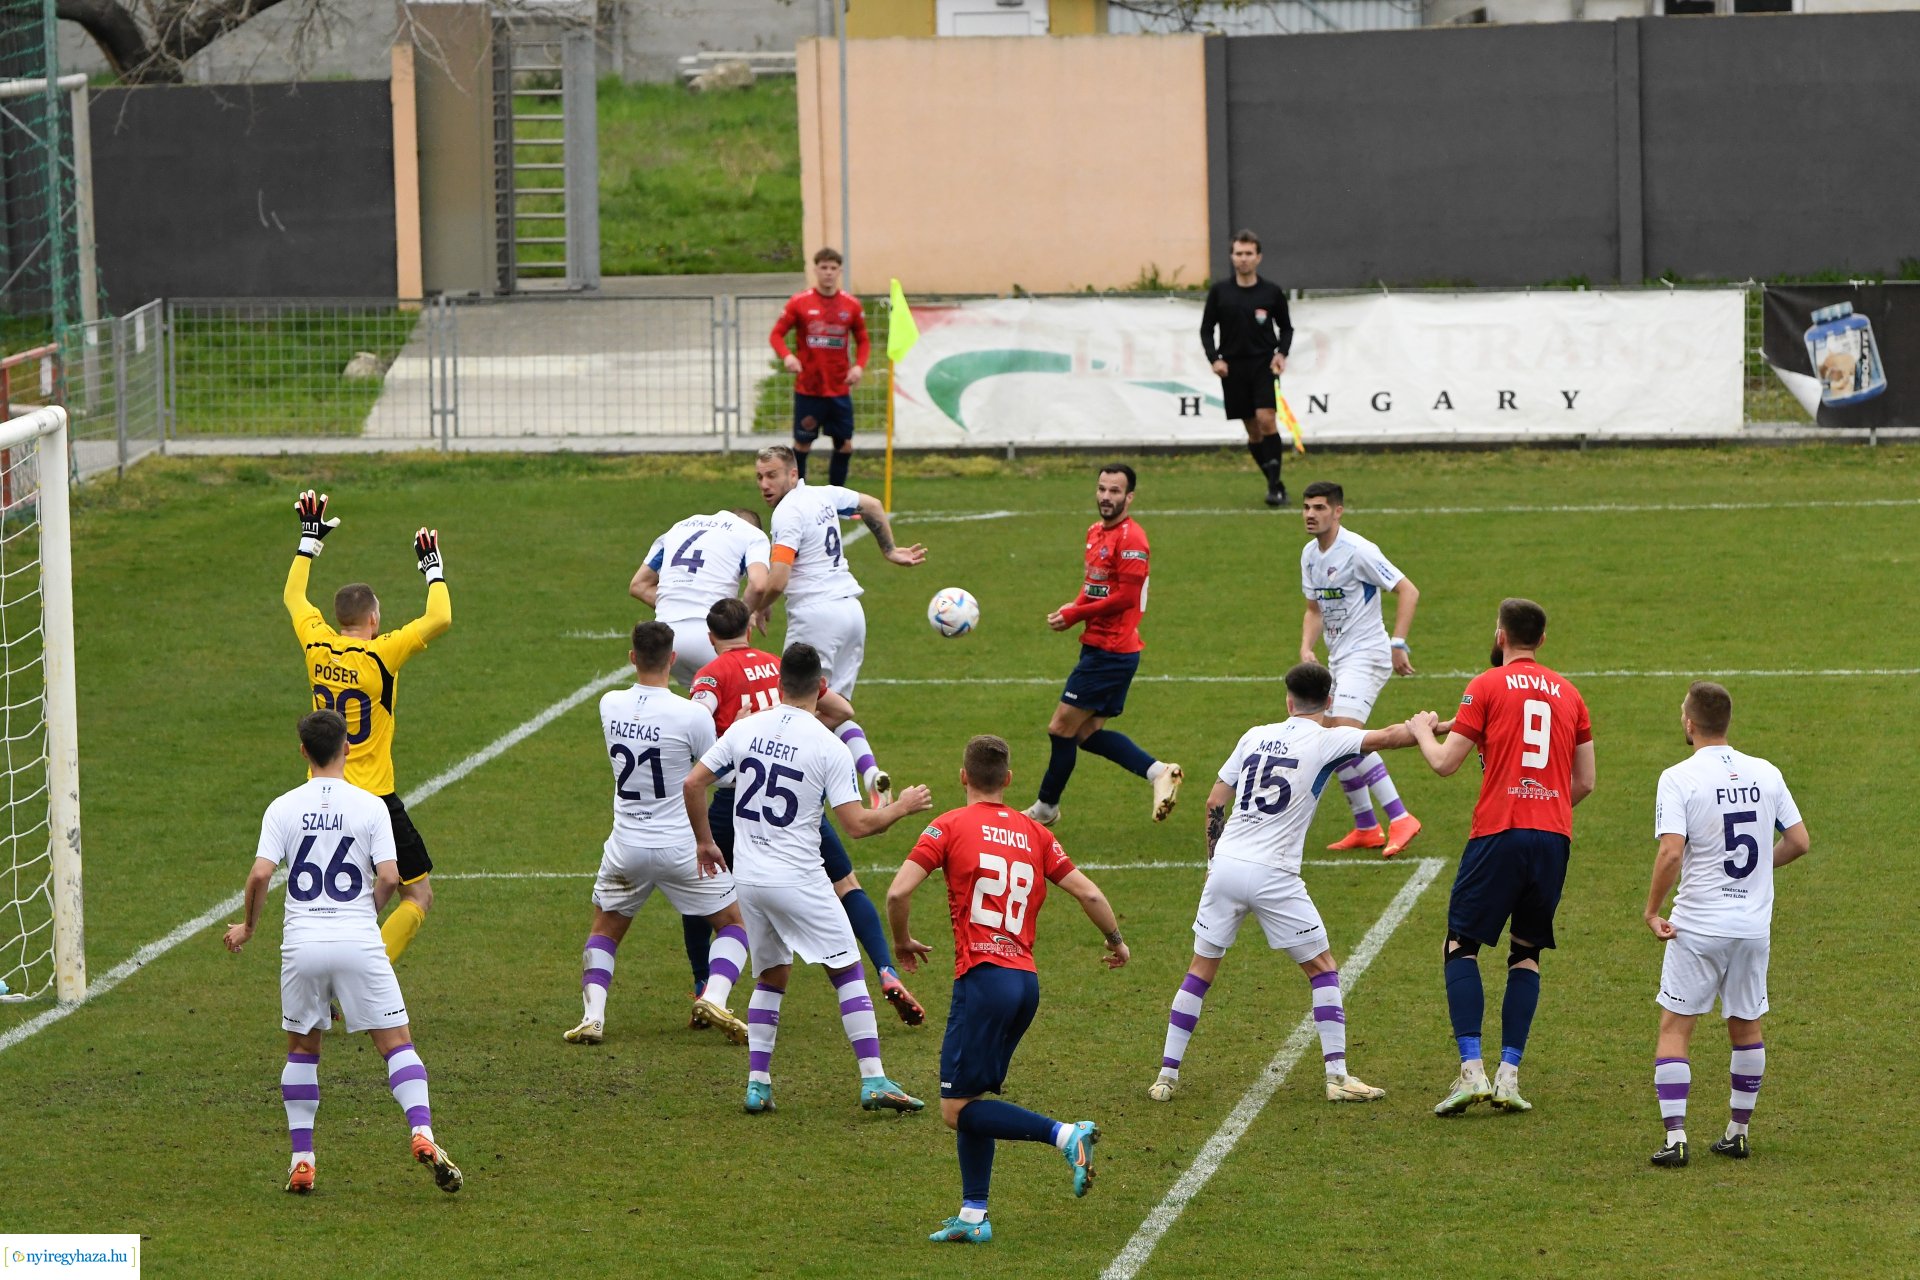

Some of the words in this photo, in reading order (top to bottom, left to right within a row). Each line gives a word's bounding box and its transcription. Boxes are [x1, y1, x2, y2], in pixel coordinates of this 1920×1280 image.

[1178, 388, 1582, 417] HNGARY
[670, 530, 708, 574] 4
[825, 526, 841, 567] 9
[315, 661, 359, 684] PÓSER
[743, 663, 780, 682] BAKI
[610, 719, 661, 742] FAZEKAS
[748, 736, 799, 763] ALBERT
[1521, 699, 1552, 769] 9
[610, 743, 667, 801] 21
[735, 757, 805, 828] 25
[1240, 753, 1300, 815] 15
[1716, 782, 1761, 805] FUTÓ
[302, 812, 344, 832] SZALAI
[981, 824, 1032, 853] SZOKOL
[1723, 810, 1759, 880] 5
[287, 834, 364, 903] 66
[970, 852, 1035, 936] 28
